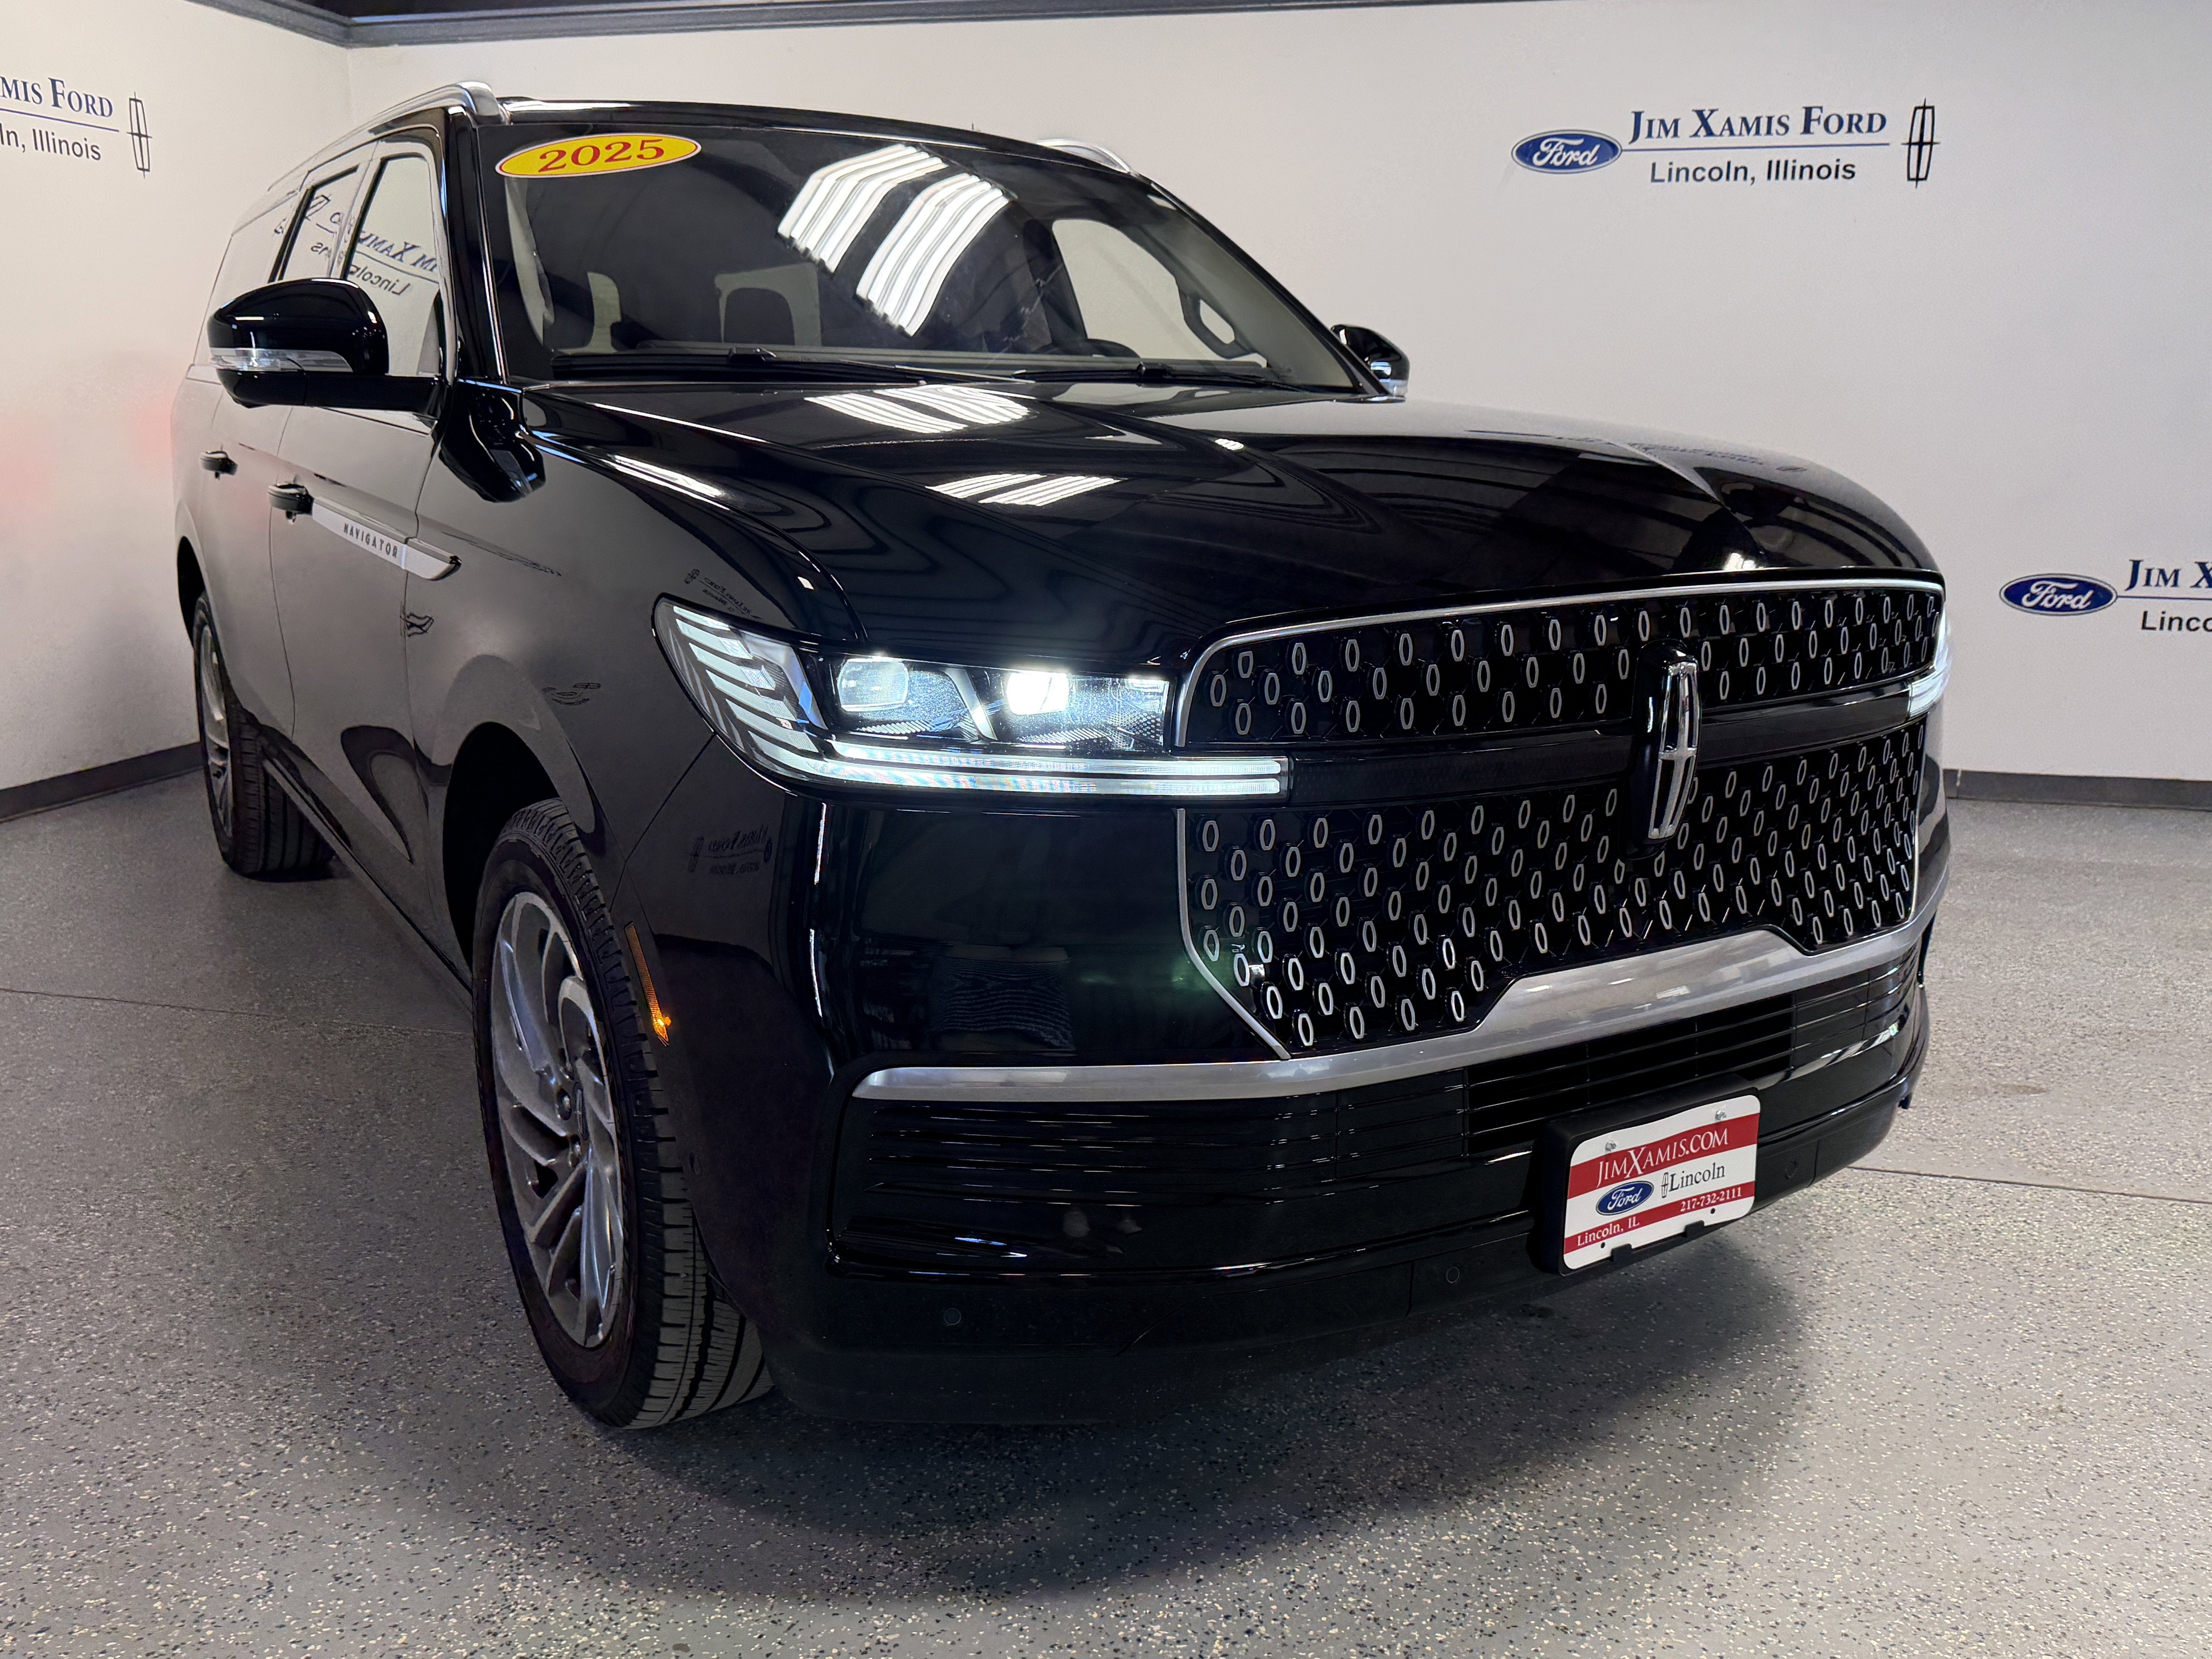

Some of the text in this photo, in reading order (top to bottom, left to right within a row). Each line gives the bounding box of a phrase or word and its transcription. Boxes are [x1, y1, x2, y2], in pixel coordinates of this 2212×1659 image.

[48, 77, 113, 117] FORD
[1628, 105, 1887, 145] JIM XAMIS FORD
[32, 128, 101, 161] Illinois
[538, 139, 665, 173] 2025
[1532, 137, 1601, 167] Ford
[1650, 158, 1856, 186] Lincoln, Illinois
[344, 522, 398, 559] NAVIGATOR
[2124, 559, 2181, 591] JIM
[2021, 580, 2094, 610] Ford
[1596, 1127, 1729, 1188] JIMXAMIS.COM
[1668, 1162, 1725, 1192] Lincoln
[1607, 1186, 1643, 1211] Ford
[1680, 1187, 1742, 1212] 217-732-2111
[1577, 1216, 1640, 1246] Lincoln, IL
